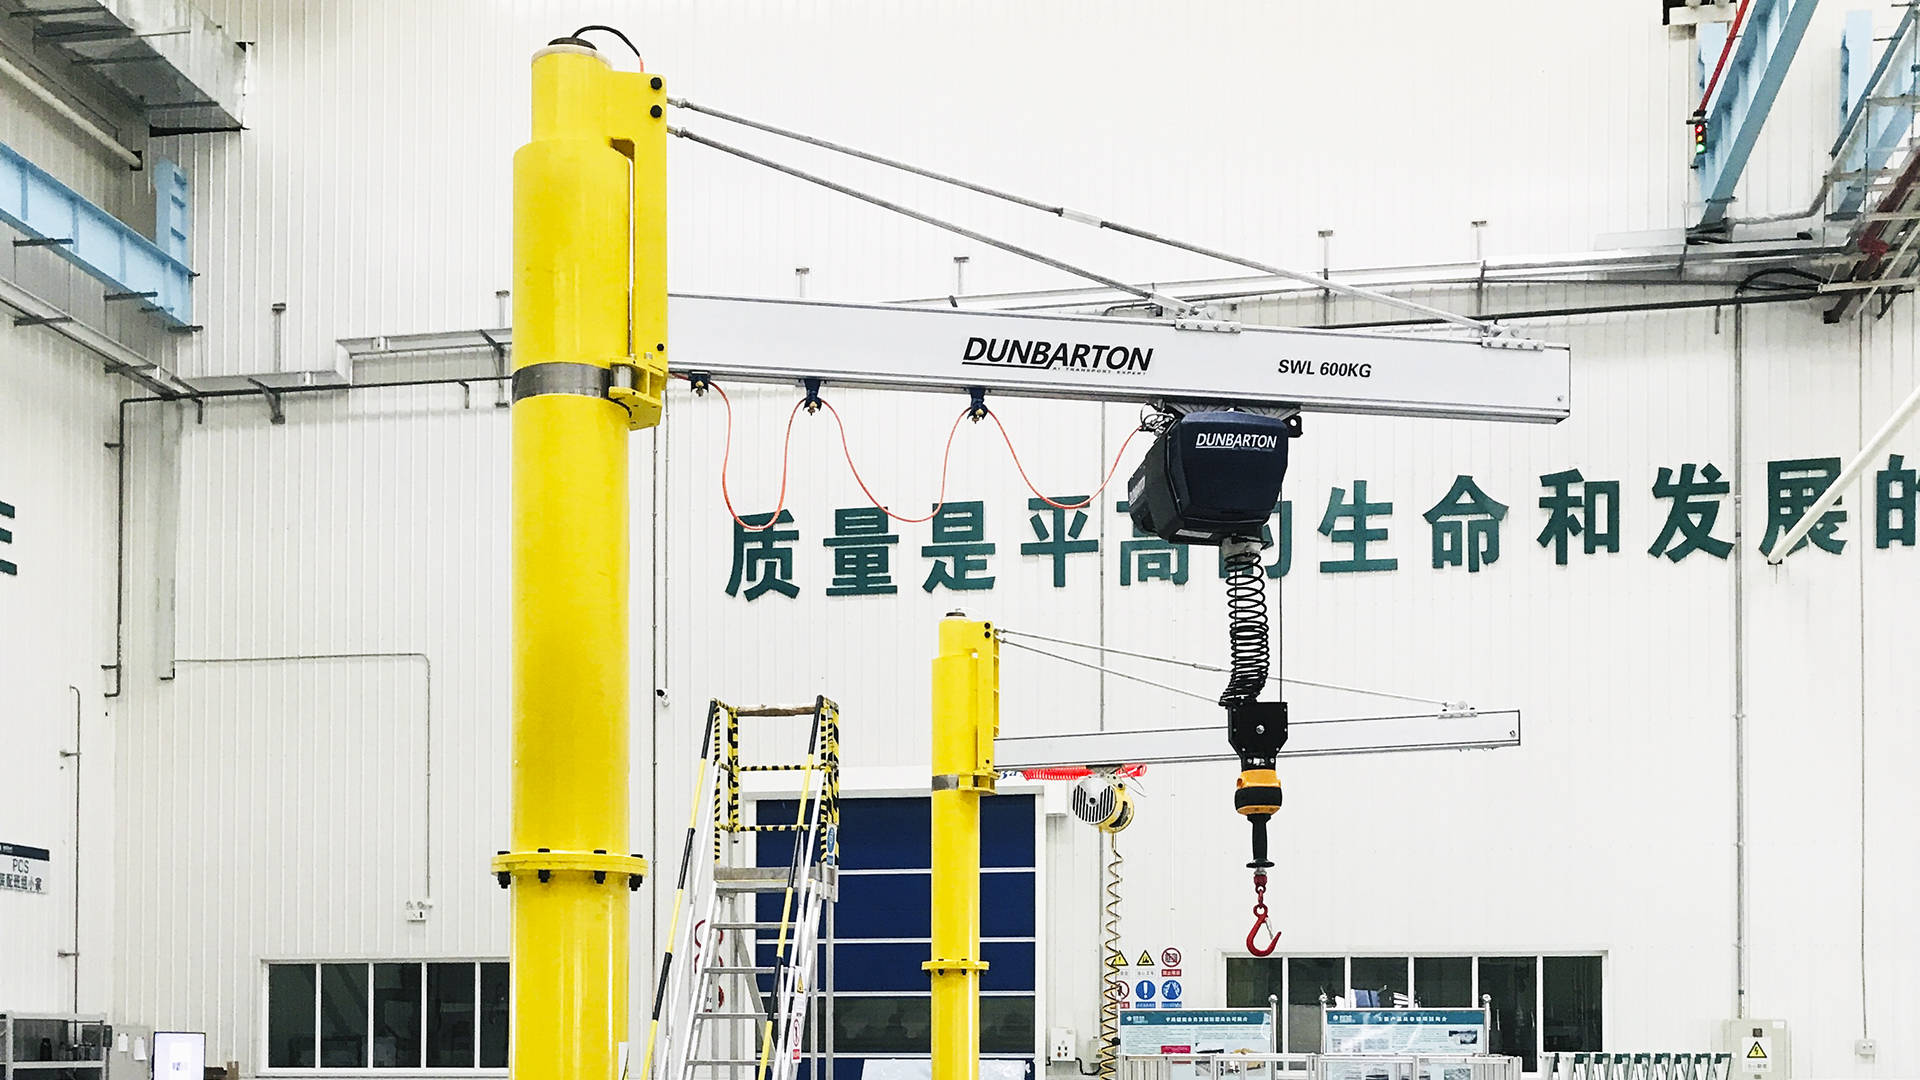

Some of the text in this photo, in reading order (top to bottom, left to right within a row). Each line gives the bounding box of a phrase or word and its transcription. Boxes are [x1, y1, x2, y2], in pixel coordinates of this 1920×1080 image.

[962, 337, 1154, 371] DUNBARTON
[1278, 359, 1372, 378] SWL 600KG
[1195, 433, 1277, 449] DUNBARTON
